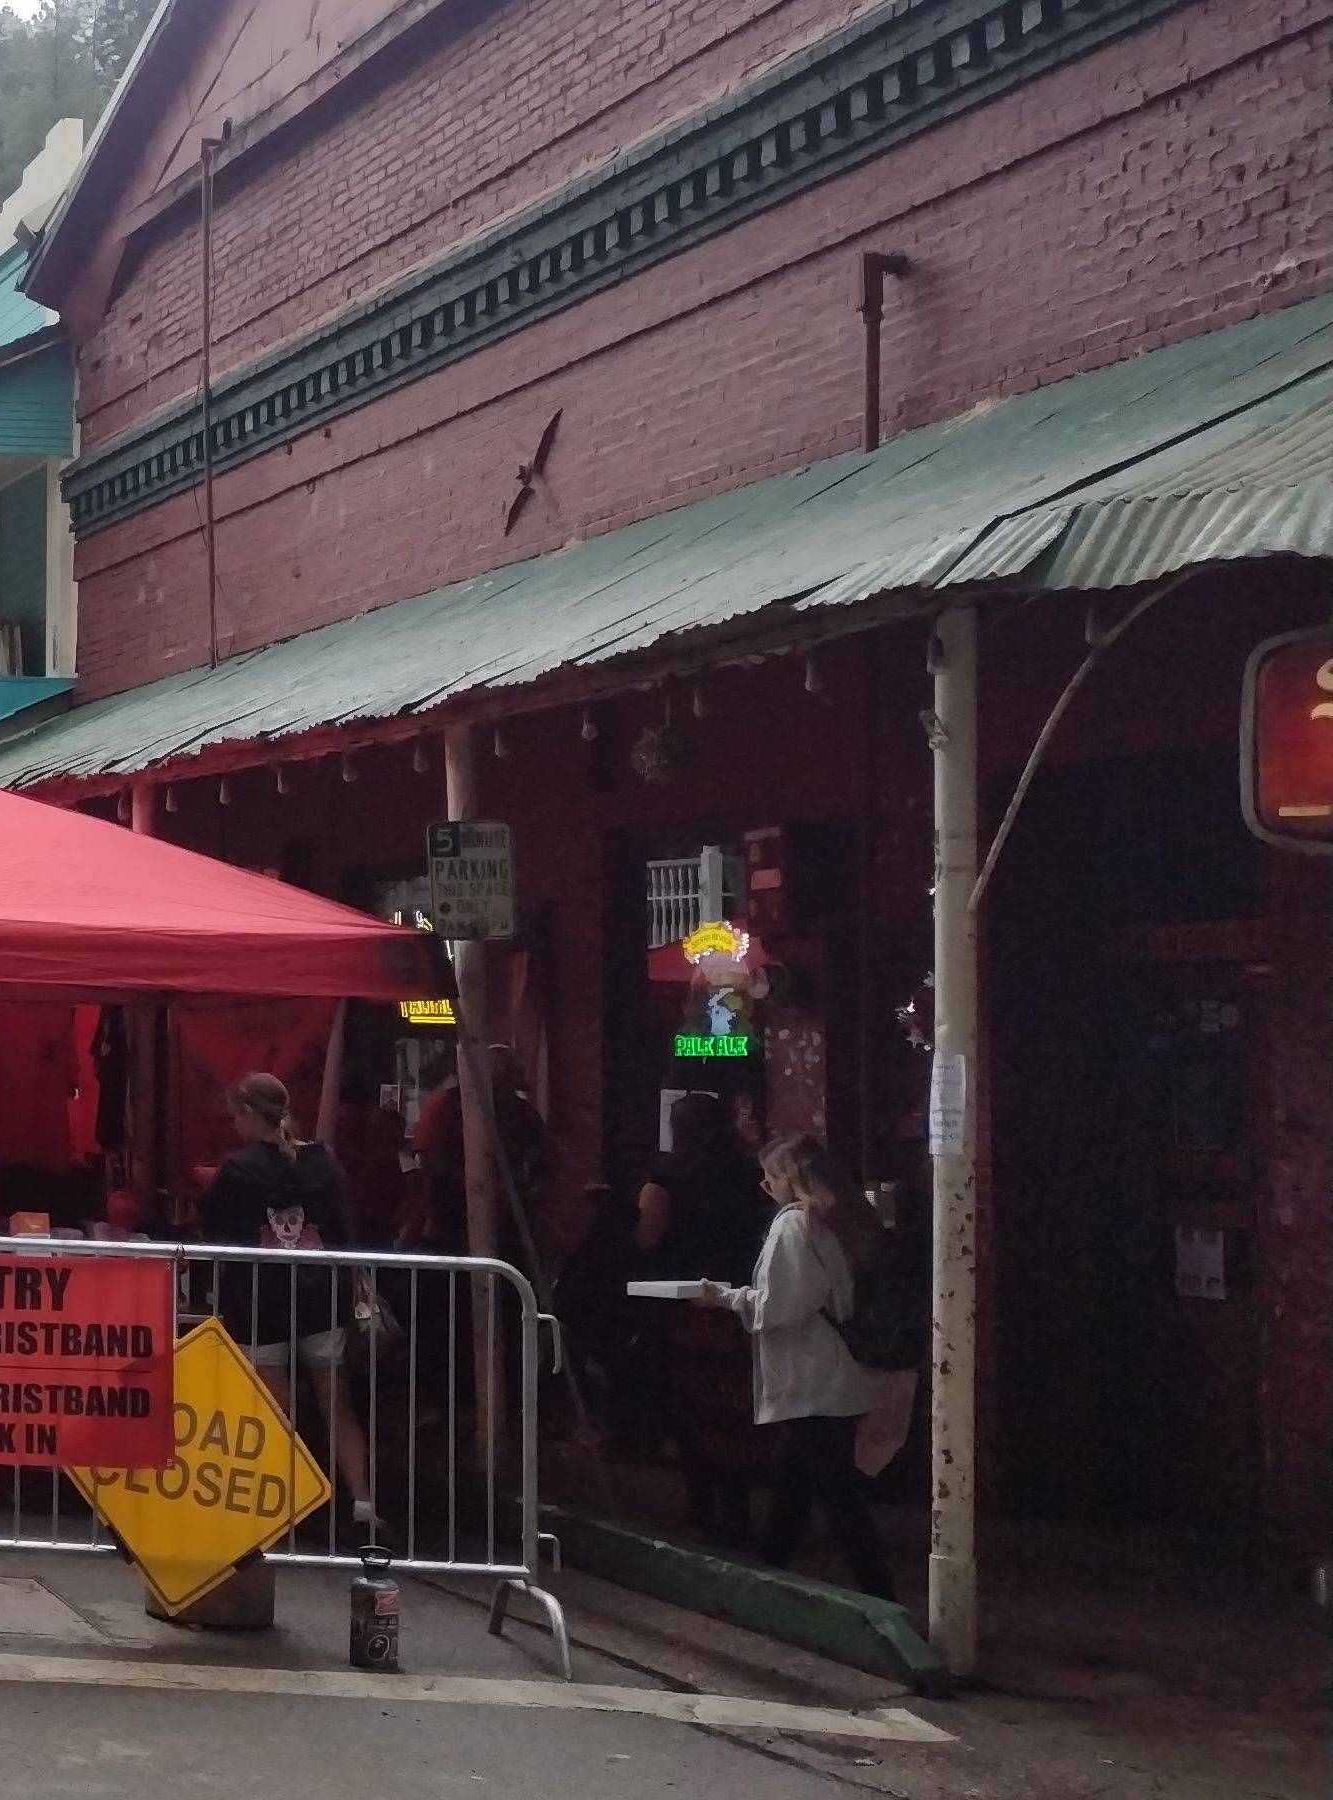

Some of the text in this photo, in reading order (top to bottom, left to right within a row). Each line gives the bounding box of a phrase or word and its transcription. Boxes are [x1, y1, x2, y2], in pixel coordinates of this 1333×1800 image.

[437, 829, 509, 852] 5 MINUTE
[435, 859, 510, 880] PARKING
[437, 882, 510, 898] THIS SPACE
[457, 900, 489, 914] ONLY
[675, 1035, 748, 1056] PALE ALE
[25, 1423, 57, 1455] IN
[173, 1402, 266, 1461] OAD
